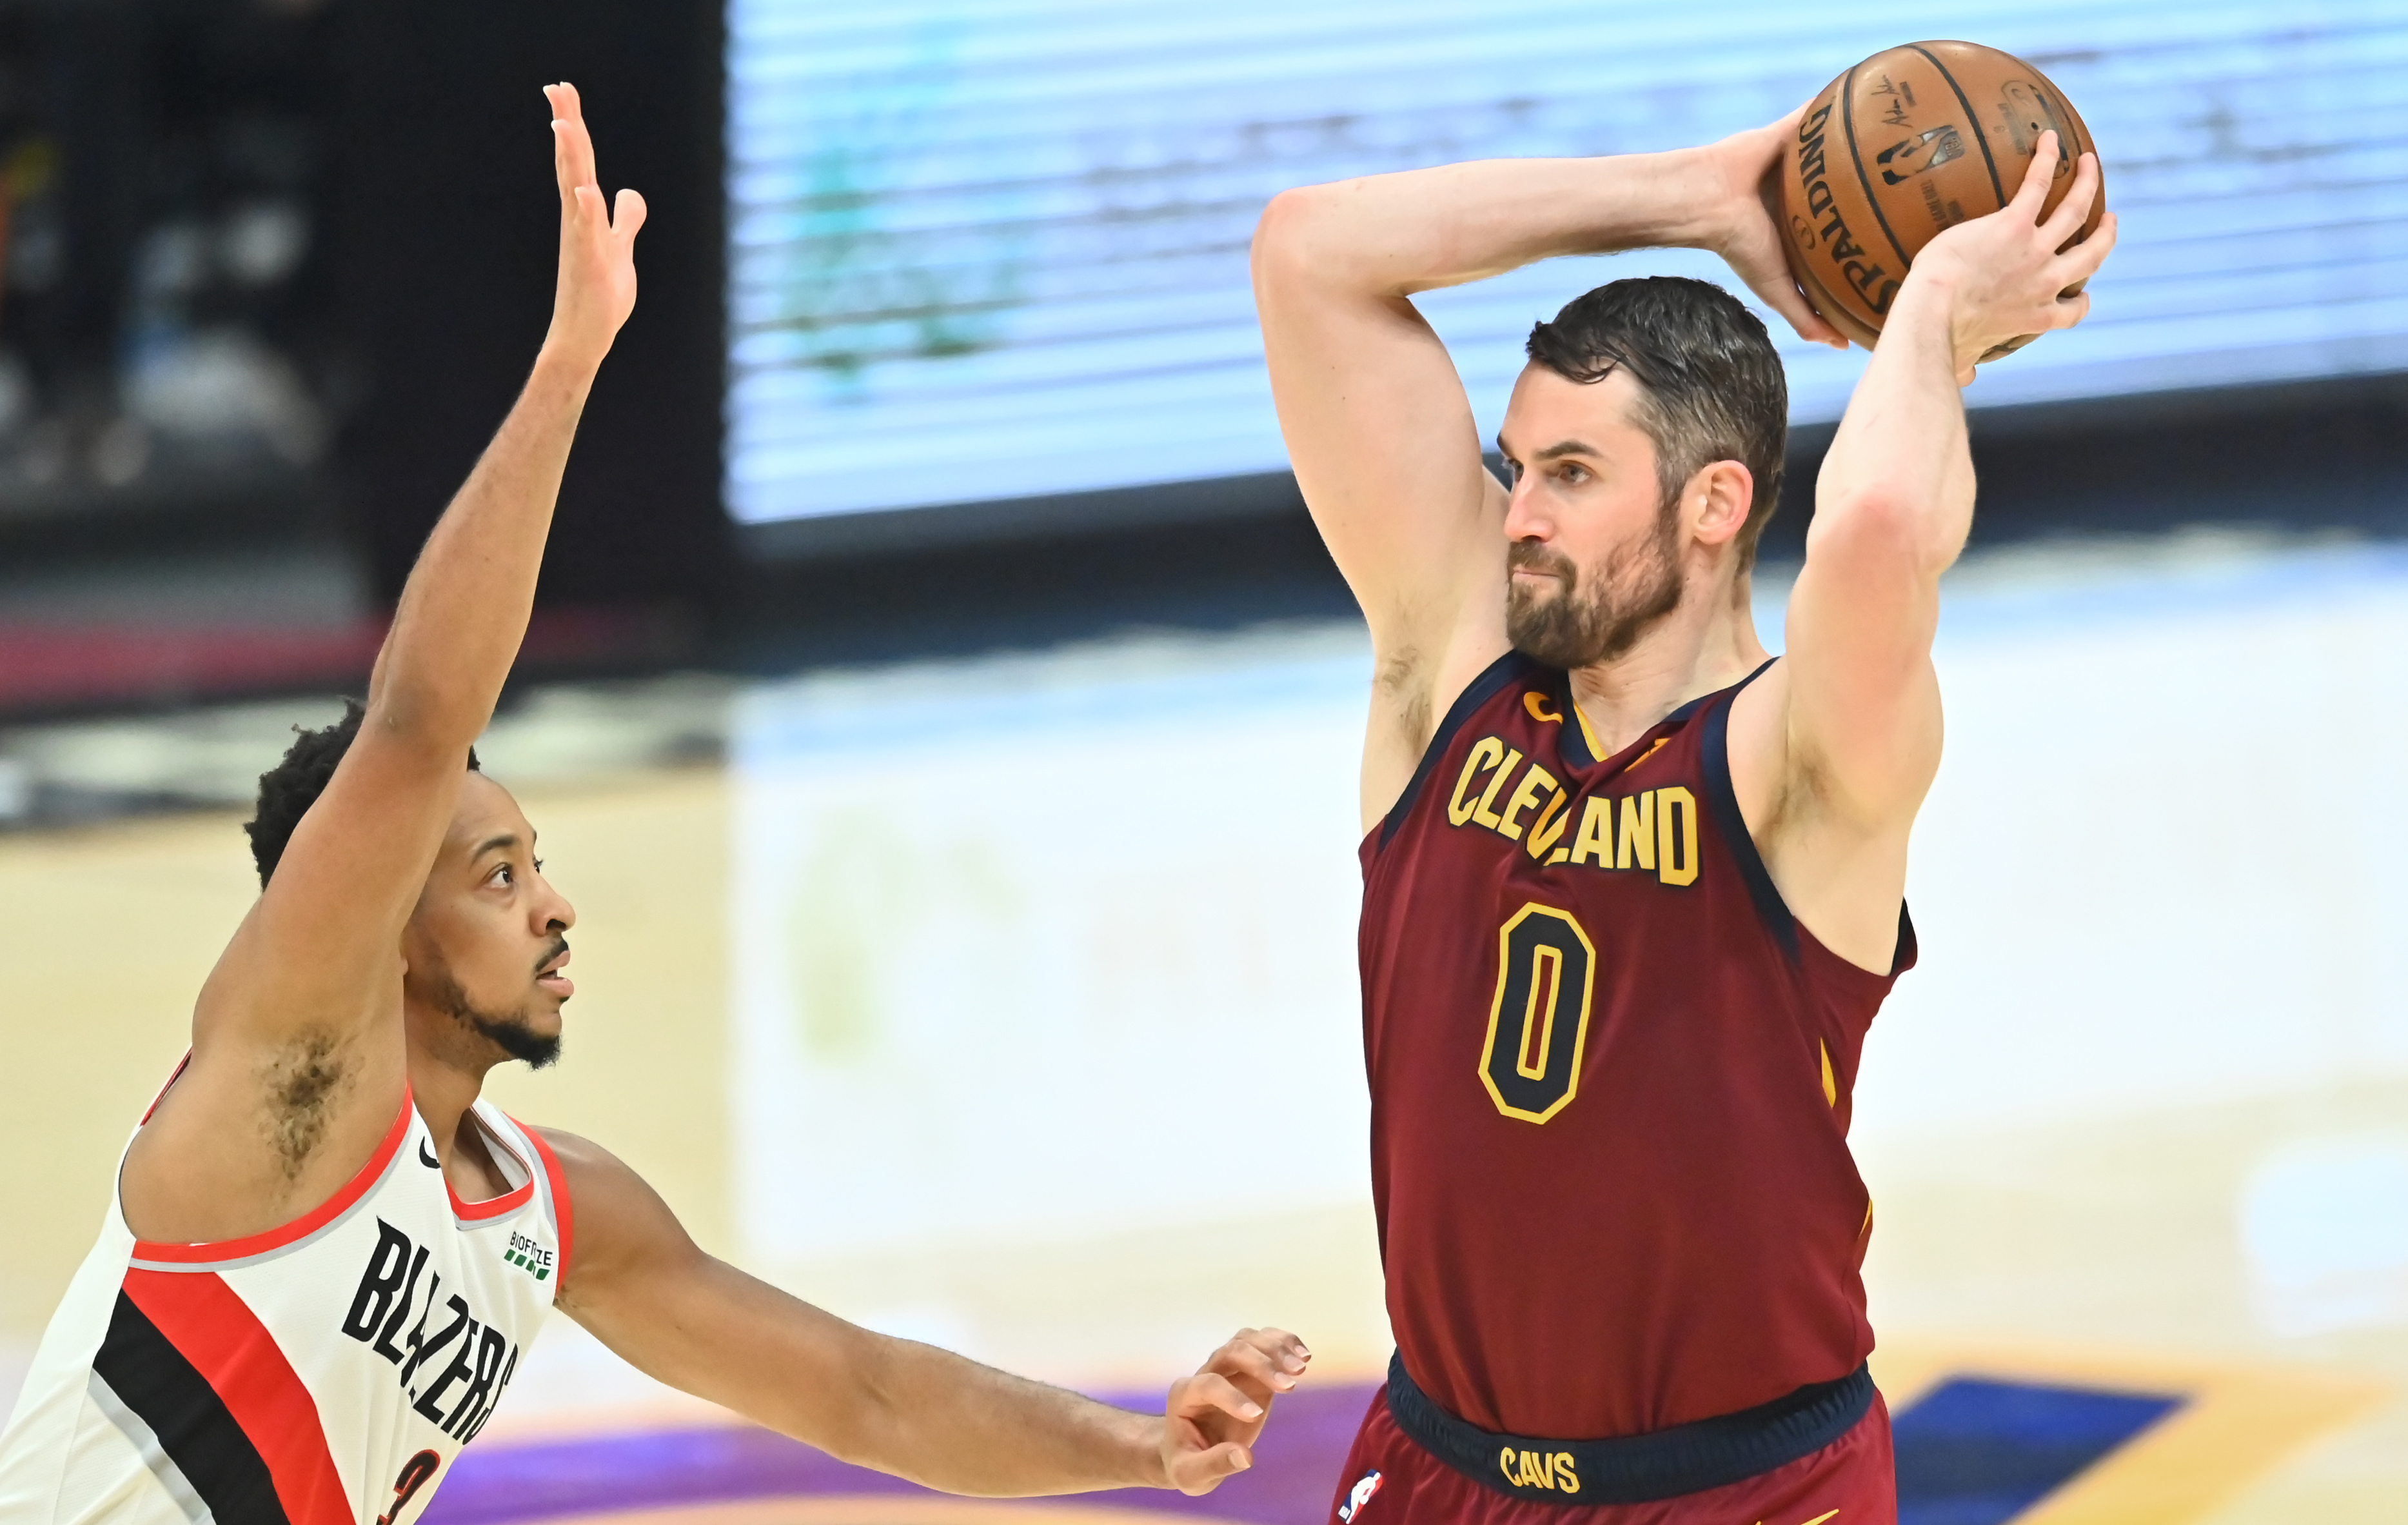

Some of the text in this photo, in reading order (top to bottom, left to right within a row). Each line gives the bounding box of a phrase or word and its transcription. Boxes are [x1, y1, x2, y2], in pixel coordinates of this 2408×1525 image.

[1799, 103, 1901, 315] SPALDING
[1477, 902, 1596, 1125] 0
[1500, 1446, 1581, 1494] CAVS
